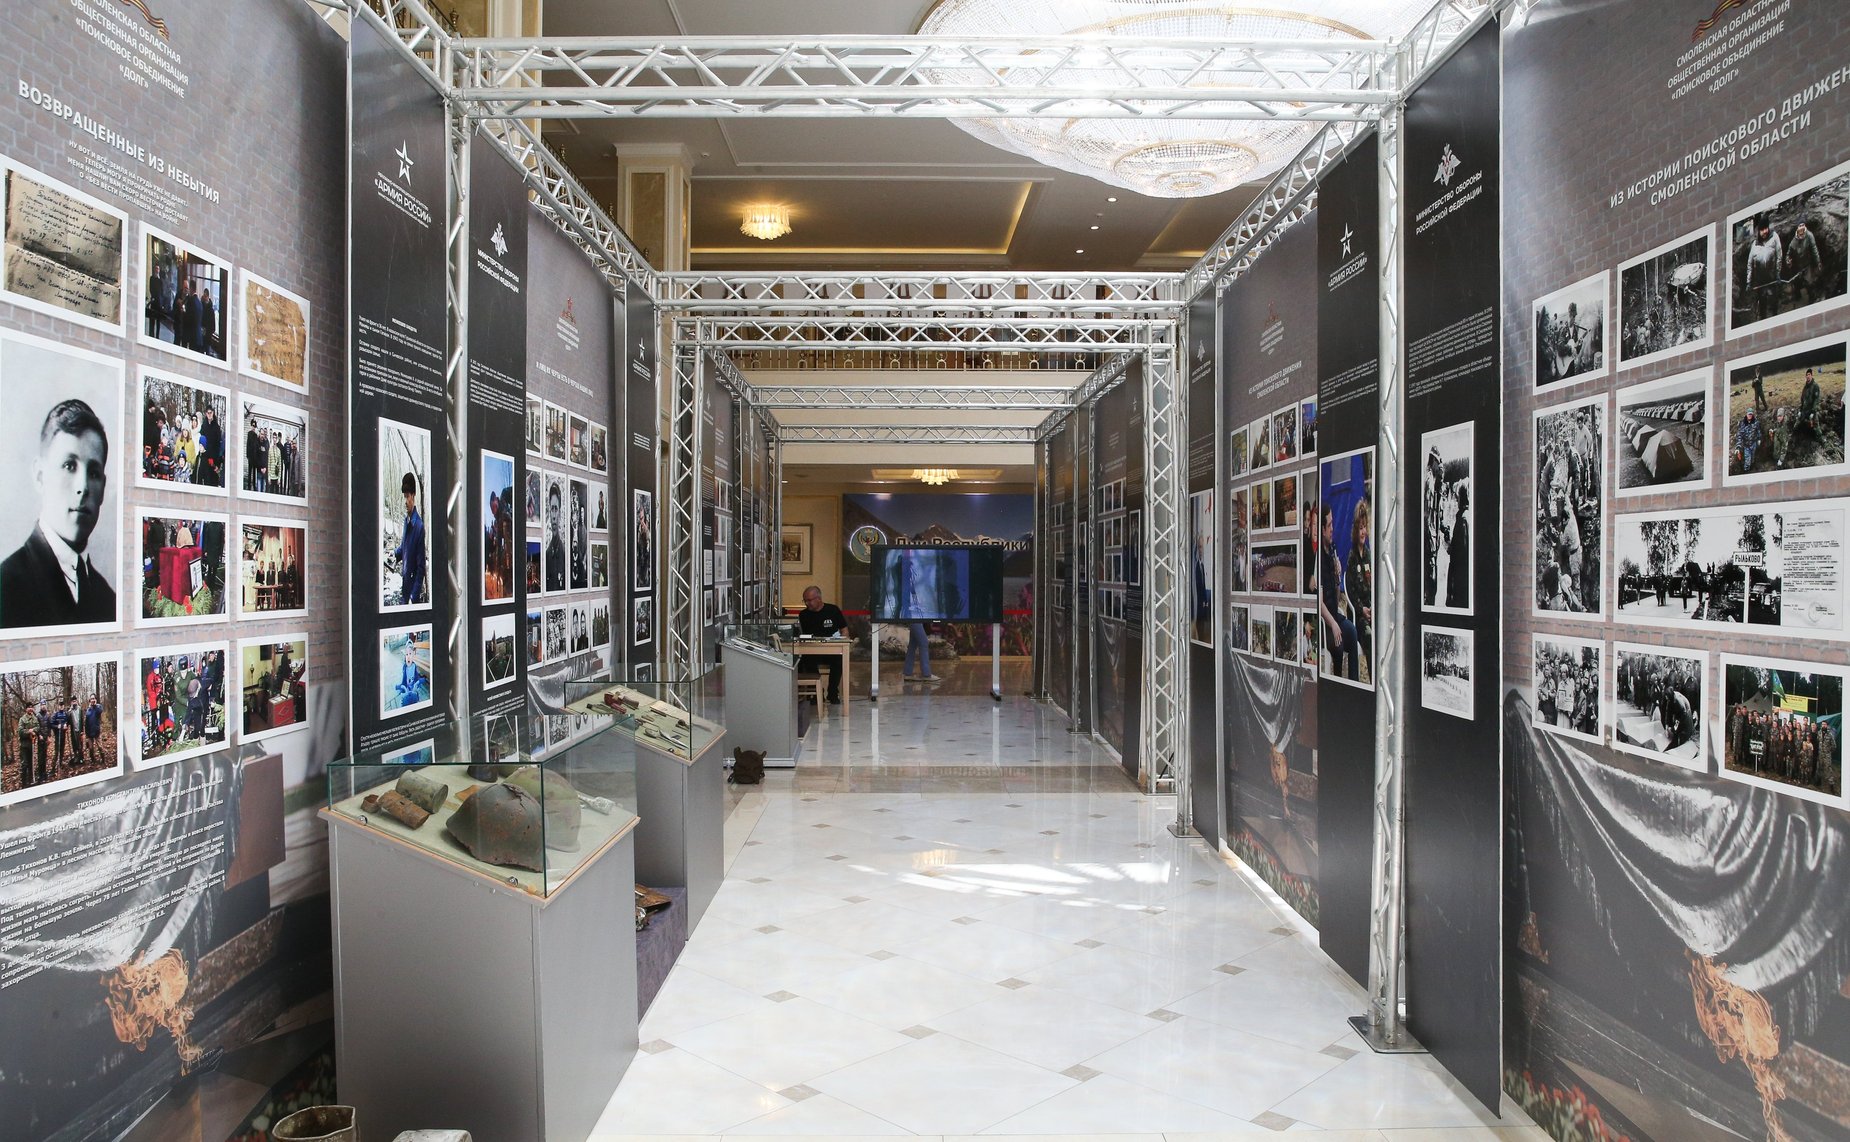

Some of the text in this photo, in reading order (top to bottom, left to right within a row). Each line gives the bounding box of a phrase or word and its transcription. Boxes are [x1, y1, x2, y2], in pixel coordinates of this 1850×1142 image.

[71, 0, 189, 85] ОБЩЕСТВЕННАЯ ОРГАНИЗАЦИЯ
[93, 0, 181, 64] ОЛЕНСКАЯ ОБЛАСТНАЯ
[1667, 0, 1790, 89] ОБЩЕСТВЕННАЯ ОРГАНИЗАЦИЯ
[1676, 25, 1728, 67] СМОЛЕНСКАЯ
[76, 17, 185, 98] «ПОИСКОВОЕ ОБЪЕДИНЕНИЕ
[119, 65, 148, 88] «ДОЛГ»
[1671, 20, 1785, 100] «ПОИСКОВОЕ ОБЪЕДИНЕНИЕ
[1708, 68, 1739, 93] «ДОЛГ»
[18, 79, 220, 204] ВОЗВРАЩЕННЫЕ ИЗ НЕБЫТИЯ
[78, 145, 90, 155] ВОТ
[110, 160, 127, 175] ЗЕМЛЯ
[128, 171, 136, 180] НА
[1610, 193, 1624, 209] ИЗ
[1627, 160, 1680, 199] ИСТОРИИ
[1685, 108, 1776, 172] ПОИСКОВОГО
[1650, 110, 1811, 206] СМОЛЕНСКОЙ ОБЛАСТИ
[67, 156, 84, 170] МЕНЯ
[109, 177, 121, 188] ВАМ
[122, 184, 140, 197] СКОРО
[140, 193, 165, 210] ВЕСТОЧКУ
[84, 156, 106, 172] ТЕПЕРЬ
[107, 168, 122, 180] МОГУ
[100, 181, 118, 196] ВЕСТИ
[375, 178, 402, 205] «АРМИЯ
[403, 195, 431, 224] РОССИИ»
[1416, 170, 1482, 222] МИНИСТЕРСТВО ОБОРОНЫ
[1416, 185, 1482, 235] РОССИЙСКОЙ ФЕДЕРАЦИИ
[1735, 554, 1760, 563] РЫЛЬКОВО
[0, 838, 18, 850] Ушел
[0, 865, 20, 878] Погиб
[21, 856, 47, 871] Тихонов
[48, 852, 60, 862] К.В.
[61, 848, 72, 858] под
[100, 834, 113, 844] 2020
[66, 853, 87, 864] лесном
[0, 913, 13, 925] Под
[15, 906, 34, 919] телом
[23, 913, 38, 925] мать
[39, 901, 67, 919] пыталась
[68, 892, 90, 908] согреть.
[92, 884, 111, 897] Галина
[112, 875, 135, 889] осталась
[24, 925, 32, 933] на
[34, 911, 61, 931] большую
[63, 904, 84, 917] землю.
[85, 896, 101, 910] Через
[103, 892, 110, 901] 78
[111, 889, 120, 898] лет
[121, 881, 138, 894] Галине
[24, 929, 41, 943] отца.
[81, 914, 117, 936] неизвестного
